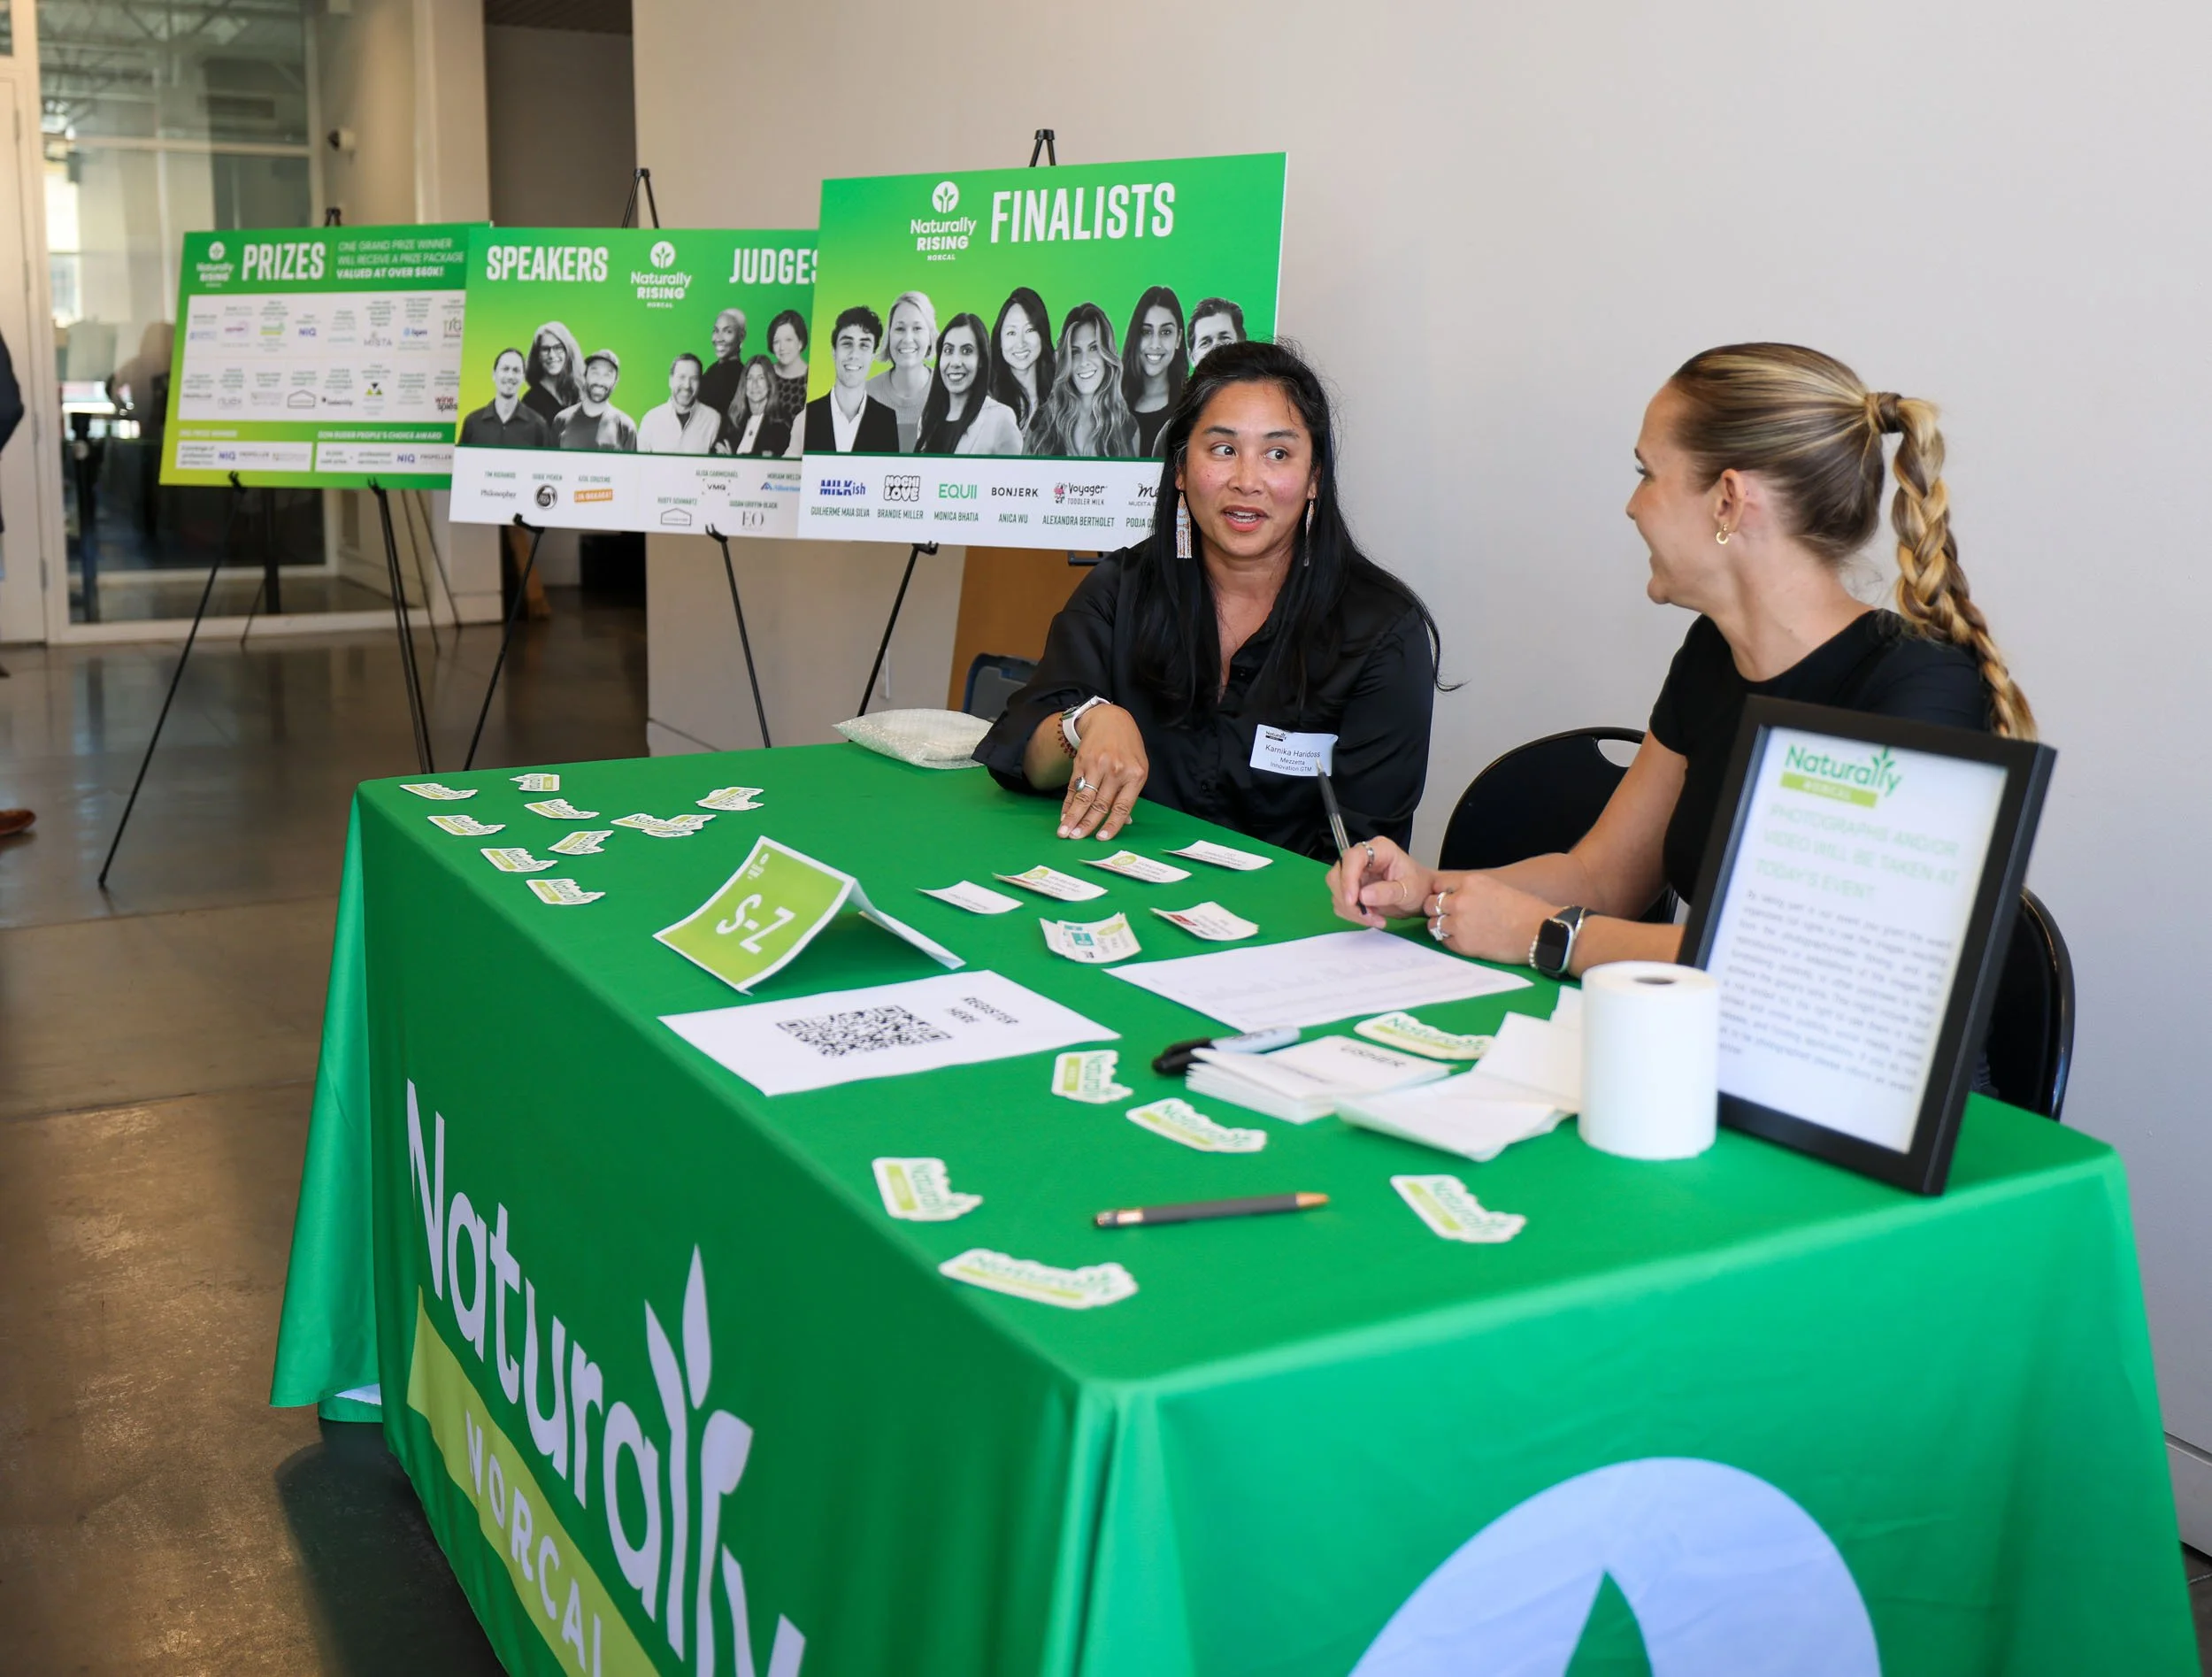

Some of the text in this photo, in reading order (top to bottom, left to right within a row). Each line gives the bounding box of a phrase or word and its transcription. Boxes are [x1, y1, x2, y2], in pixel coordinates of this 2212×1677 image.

[990, 181, 1175, 243] FINALISTS
[910, 216, 977, 236] Naturally
[917, 236, 969, 251] RISING
[242, 242, 326, 281] PRIZES
[486, 245, 609, 282] SPEAKERS
[336, 268, 373, 280] VALUED
[373, 267, 388, 278] AT
[388, 267, 413, 278] OVER
[631, 271, 692, 288] Naturally
[637, 287, 685, 299] RISING
[396, 453, 415, 464] NIQ
[819, 479, 866, 496] MILKish
[885, 475, 920, 488] MOCHI
[884, 486, 919, 502] LOVE
[938, 483, 978, 500] EQUII
[991, 487, 1039, 497] BONJERK
[1068, 482, 1106, 496] Voyager
[810, 506, 870, 517] GUILHERME MAIA SILVA
[877, 509, 924, 519] BRANDIE MILLER
[933, 511, 979, 522] MONICA BHATIA
[998, 512, 1028, 523] ANICA WU
[1042, 515, 1115, 527] ALEXANDRA BERTHOLET
[1125, 517, 1146, 527] POOJA
[1265, 744, 1292, 757] Karnika
[1271, 762, 1299, 772] Innovation
[1279, 757, 1305, 765] Mezzetta
[1785, 744, 1902, 798] Naturally
[715, 894, 795, 954] S-Z
